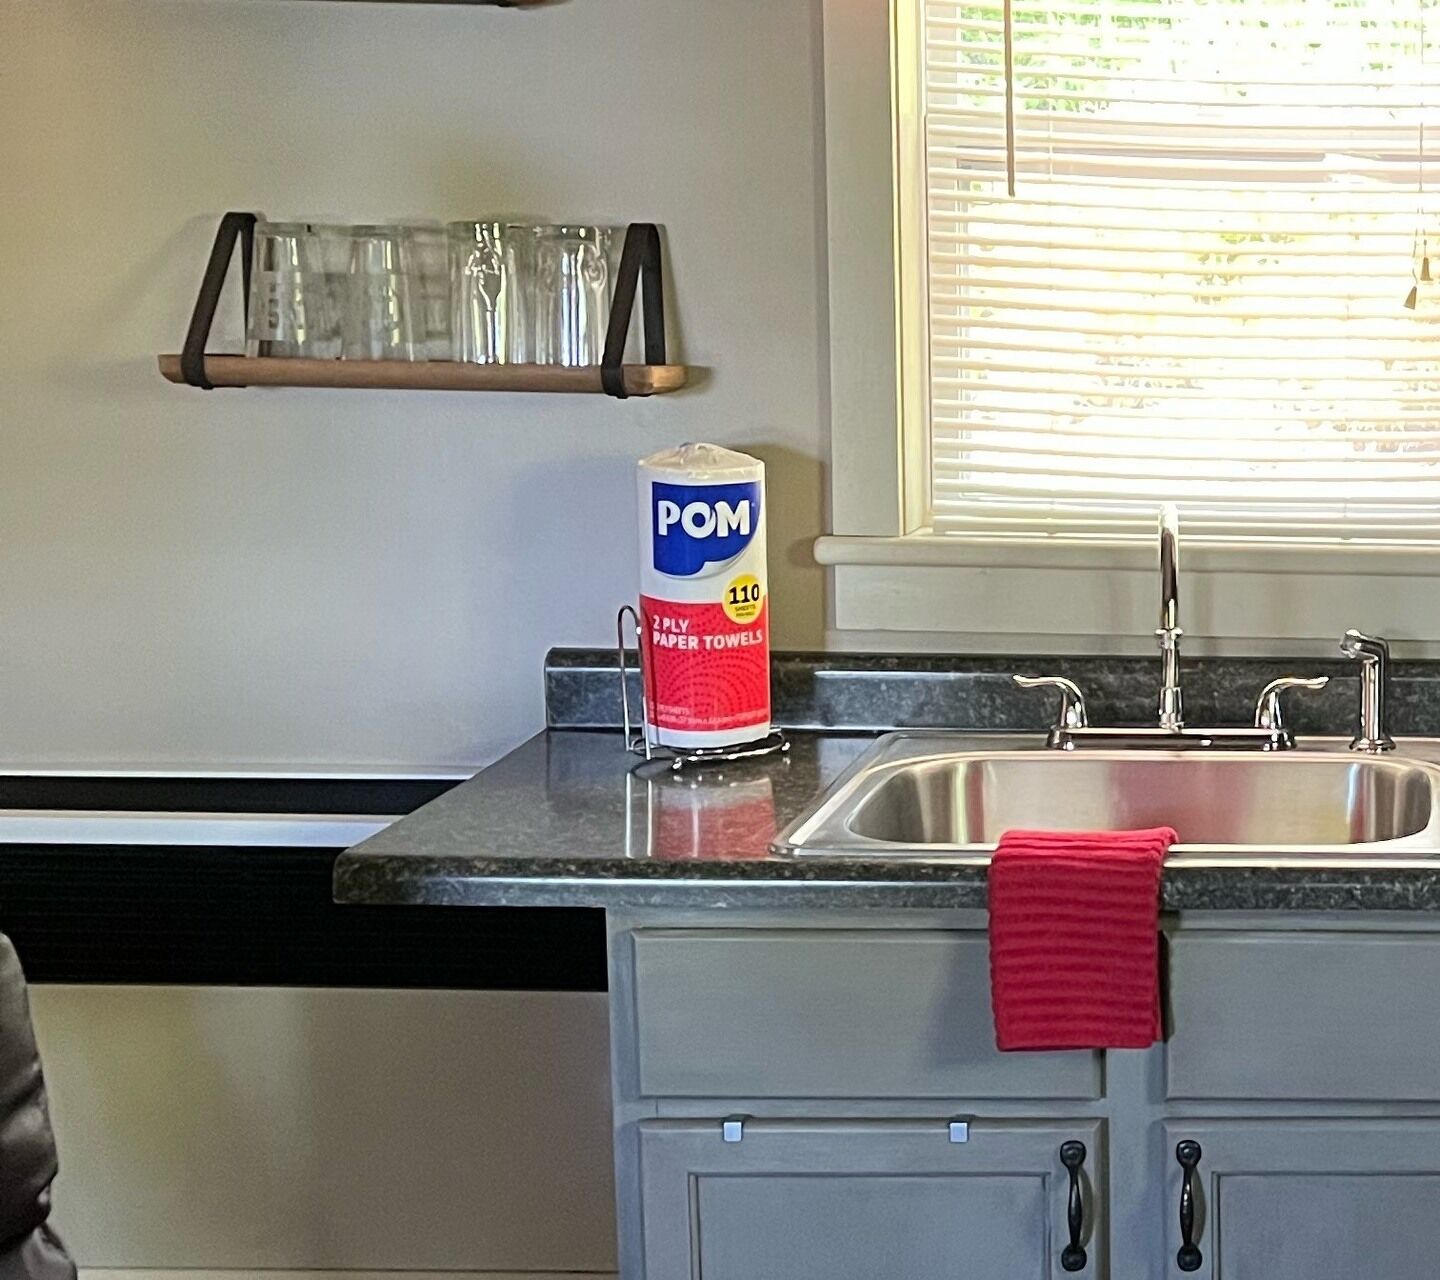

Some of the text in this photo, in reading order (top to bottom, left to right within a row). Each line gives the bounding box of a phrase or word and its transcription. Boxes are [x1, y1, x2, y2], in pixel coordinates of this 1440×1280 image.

[658, 500, 750, 539] POM
[729, 584, 760, 605] 110
[653, 614, 690, 634] 2 PLY
[653, 629, 763, 651] PAPER TOWELS
